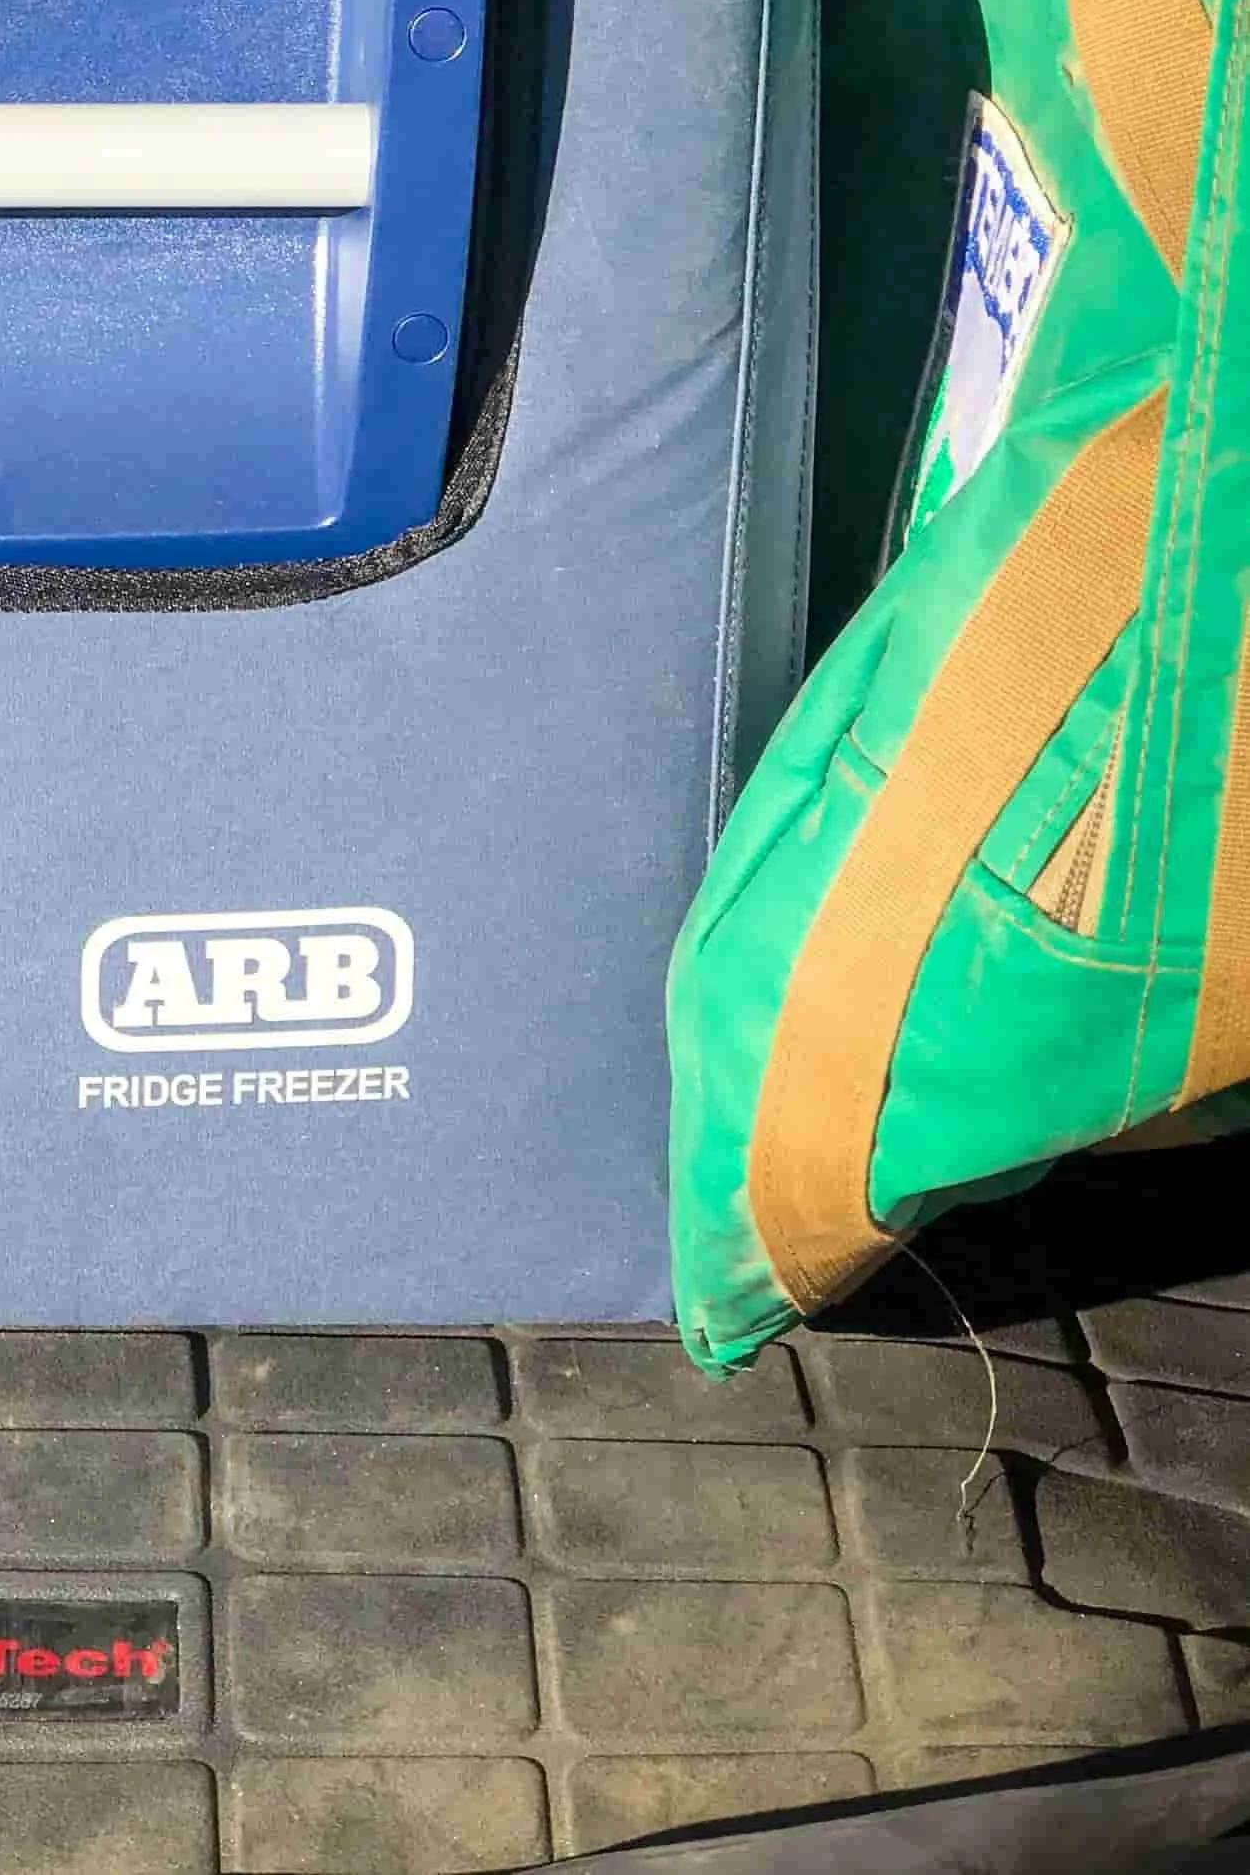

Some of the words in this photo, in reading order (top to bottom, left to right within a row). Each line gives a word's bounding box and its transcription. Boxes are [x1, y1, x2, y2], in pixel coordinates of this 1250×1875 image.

[113, 934, 382, 1027] ARB
[77, 1073, 223, 1110] FRIDGE
[232, 1065, 411, 1104] FREEZER
